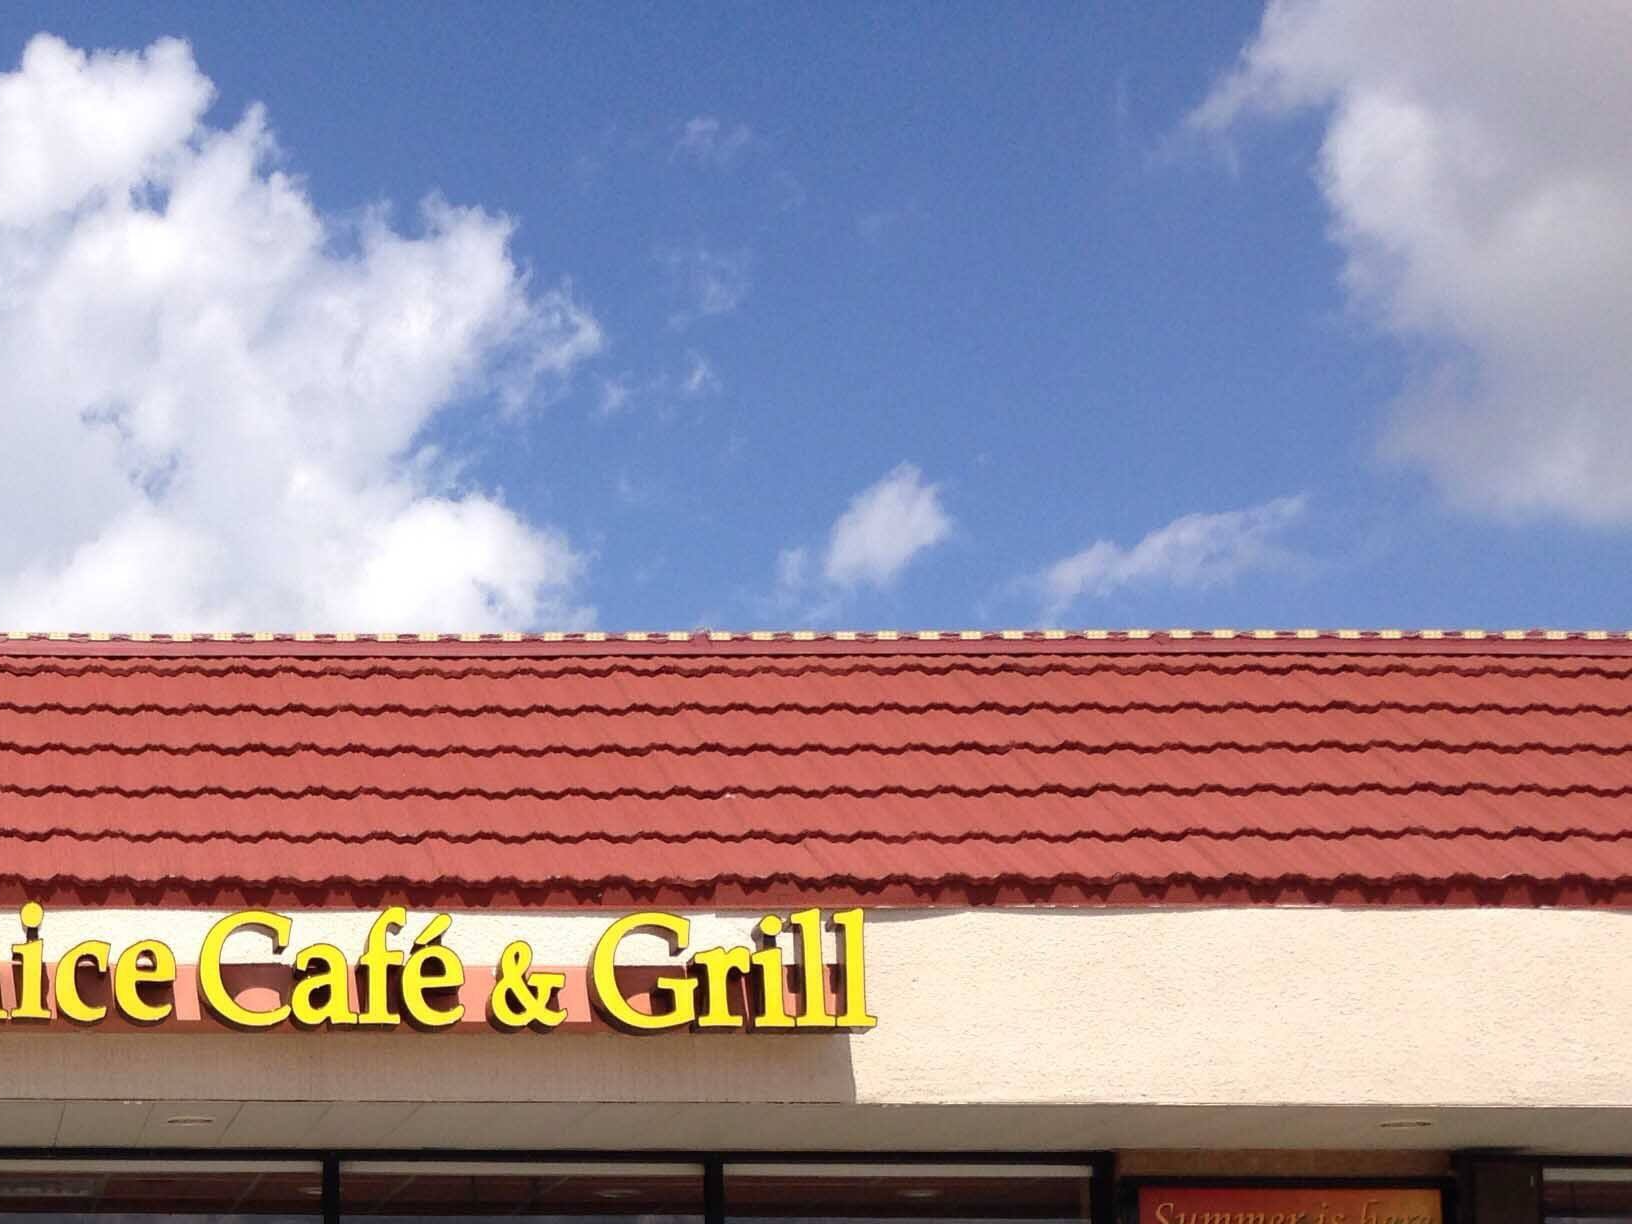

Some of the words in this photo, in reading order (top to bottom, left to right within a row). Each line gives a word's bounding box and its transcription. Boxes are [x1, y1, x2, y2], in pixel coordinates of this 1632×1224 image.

[198, 906, 465, 1030] Café
[490, 939, 568, 1028] &
[594, 906, 877, 1030] Grill
